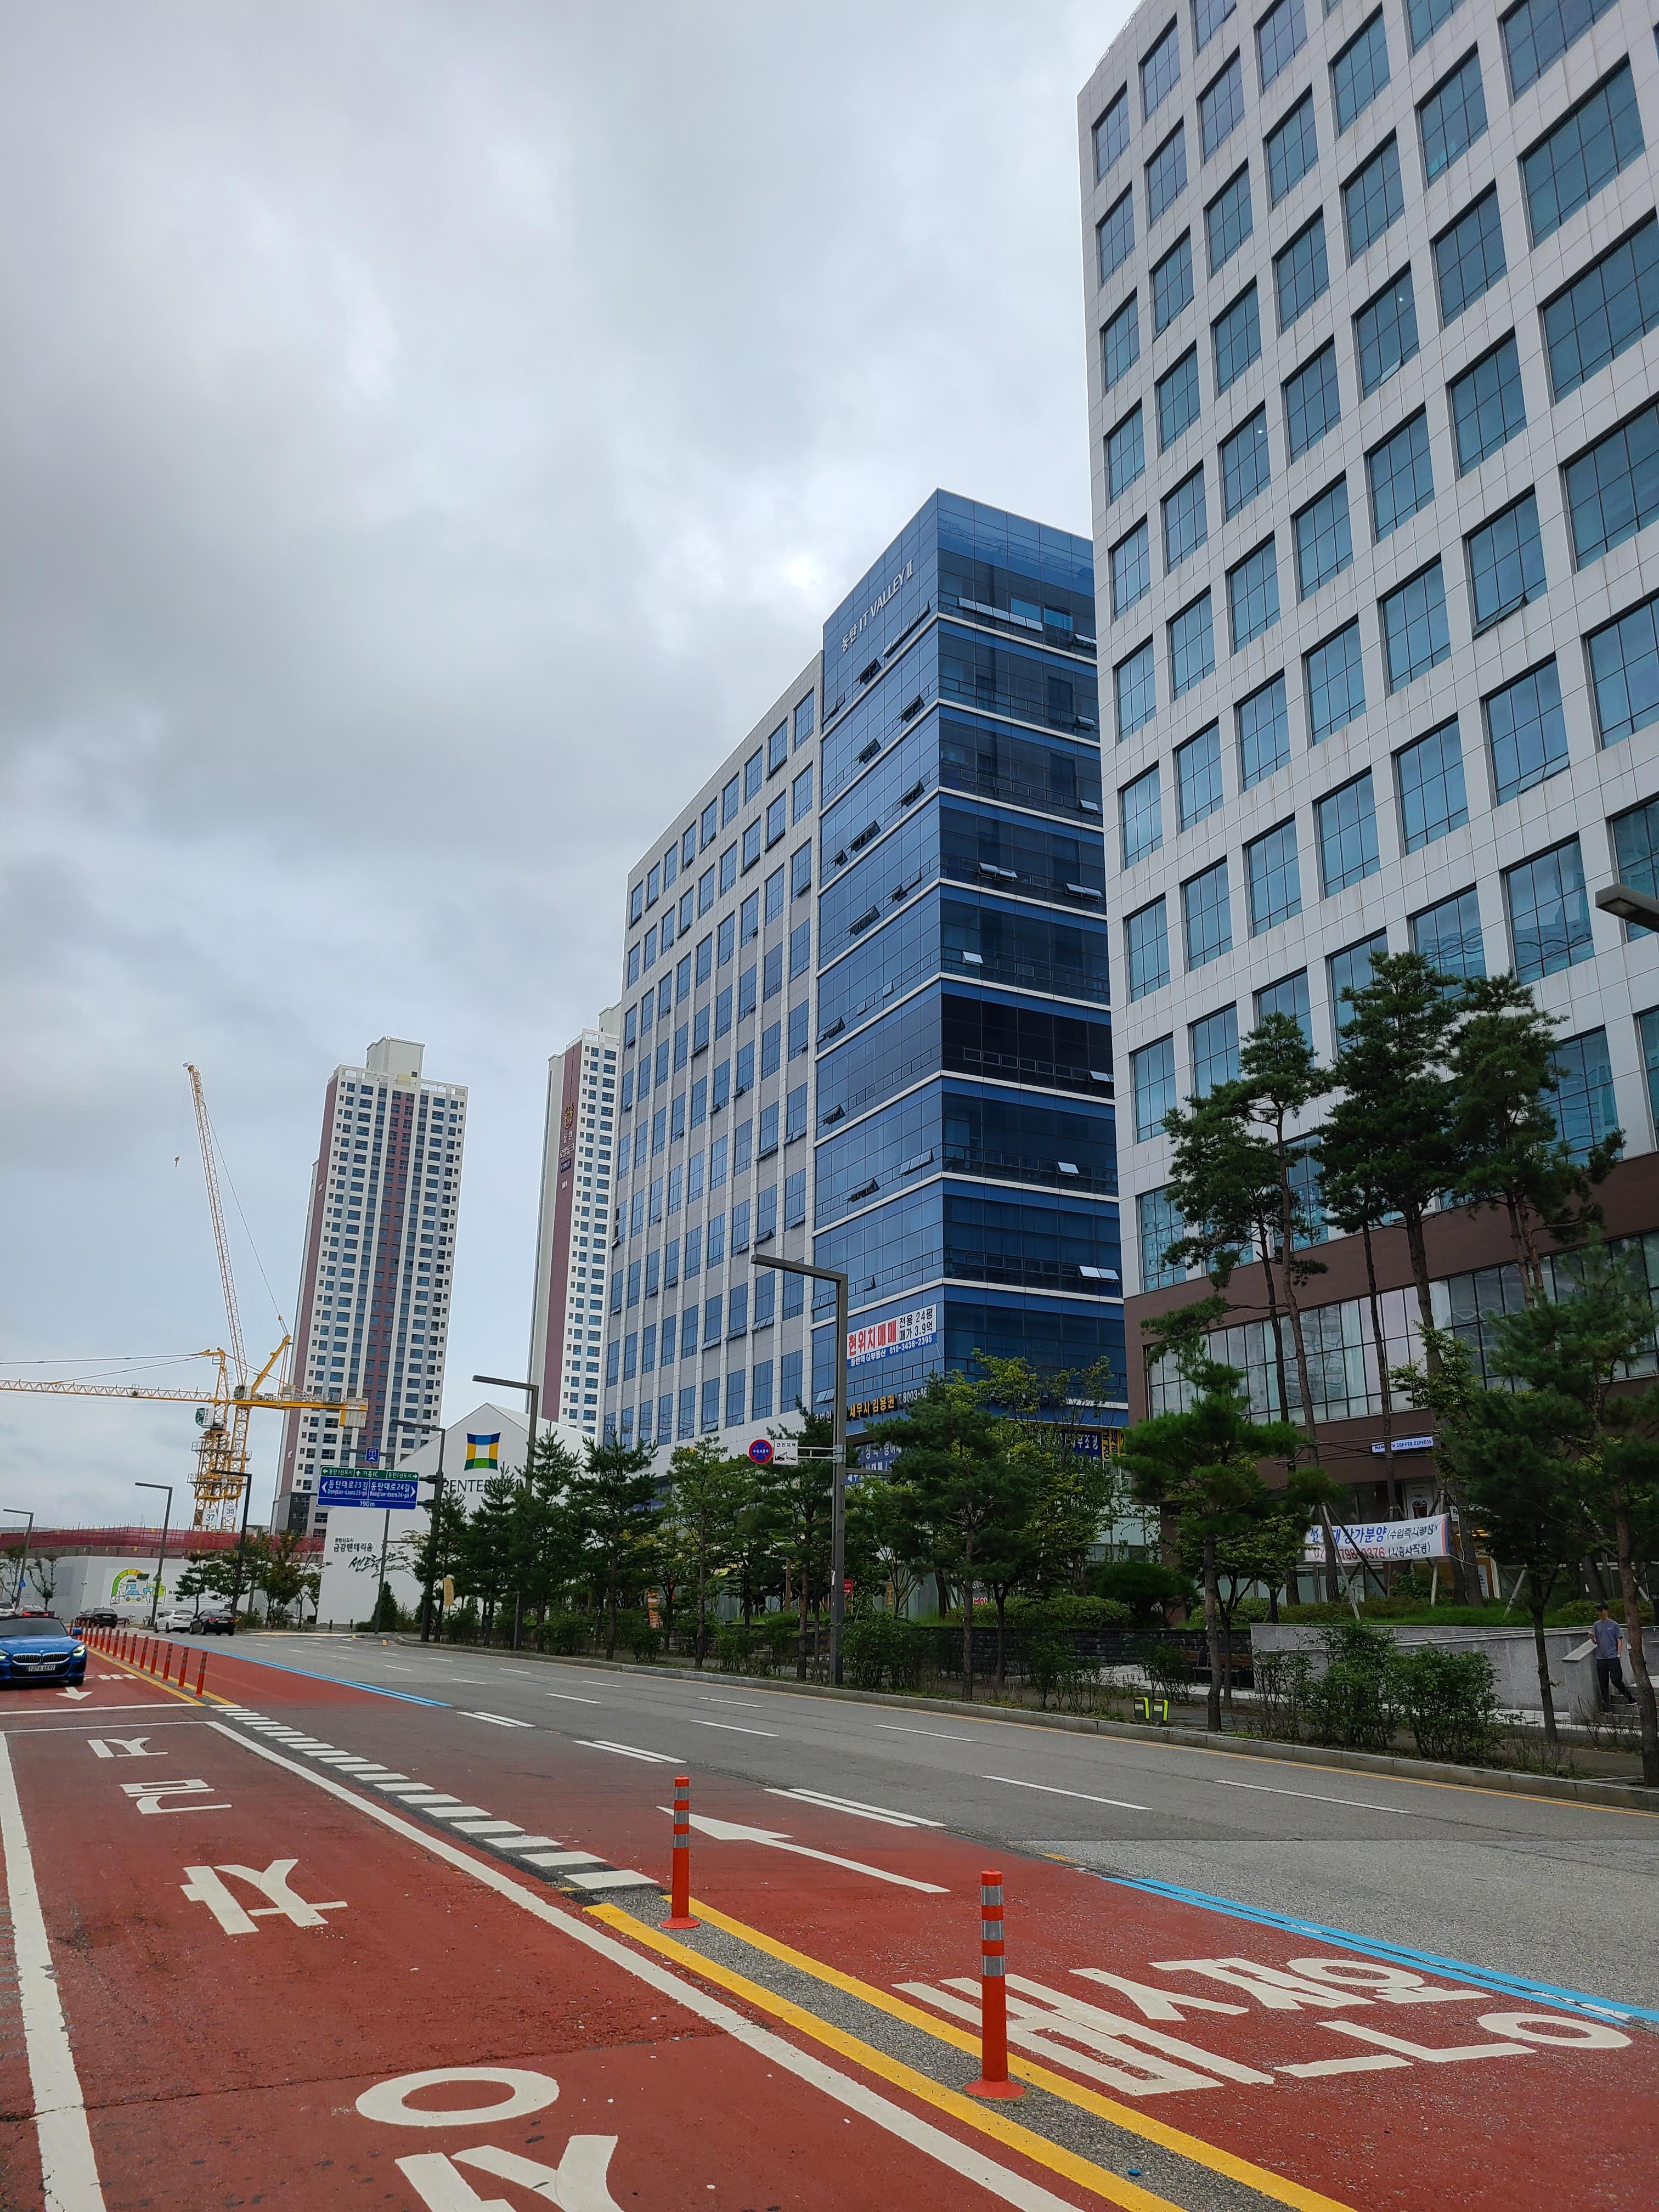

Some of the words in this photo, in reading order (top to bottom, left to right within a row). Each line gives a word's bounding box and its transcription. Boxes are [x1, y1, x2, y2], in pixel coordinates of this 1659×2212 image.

[842, 624, 857, 652] 동탄
[860, 610, 869, 632] IT
[870, 568, 905, 618] VALLEY
[899, 1314, 913, 1329] 전용
[916, 1307, 933, 1323] 24평
[849, 1319, 896, 1357] 현위치매매
[899, 1327, 912, 1341] 매가
[915, 1321, 933, 1336] 3.9억
[850, 1355, 865, 1367] 동탄역
[866, 1349, 887, 1362] Q부동산
[889, 1335, 932, 1355] 010-3436-2395
[849, 1403, 870, 1418] 세무사
[872, 1395, 895, 1413] 김용권
[329, 1480, 368, 1491] 동탄대로23길
[370, 1482, 410, 1493] 동탄대로24길
[1343, 1526, 1387, 1544] 상가분양
[334, 1543, 374, 1552] 금강펜테리움
